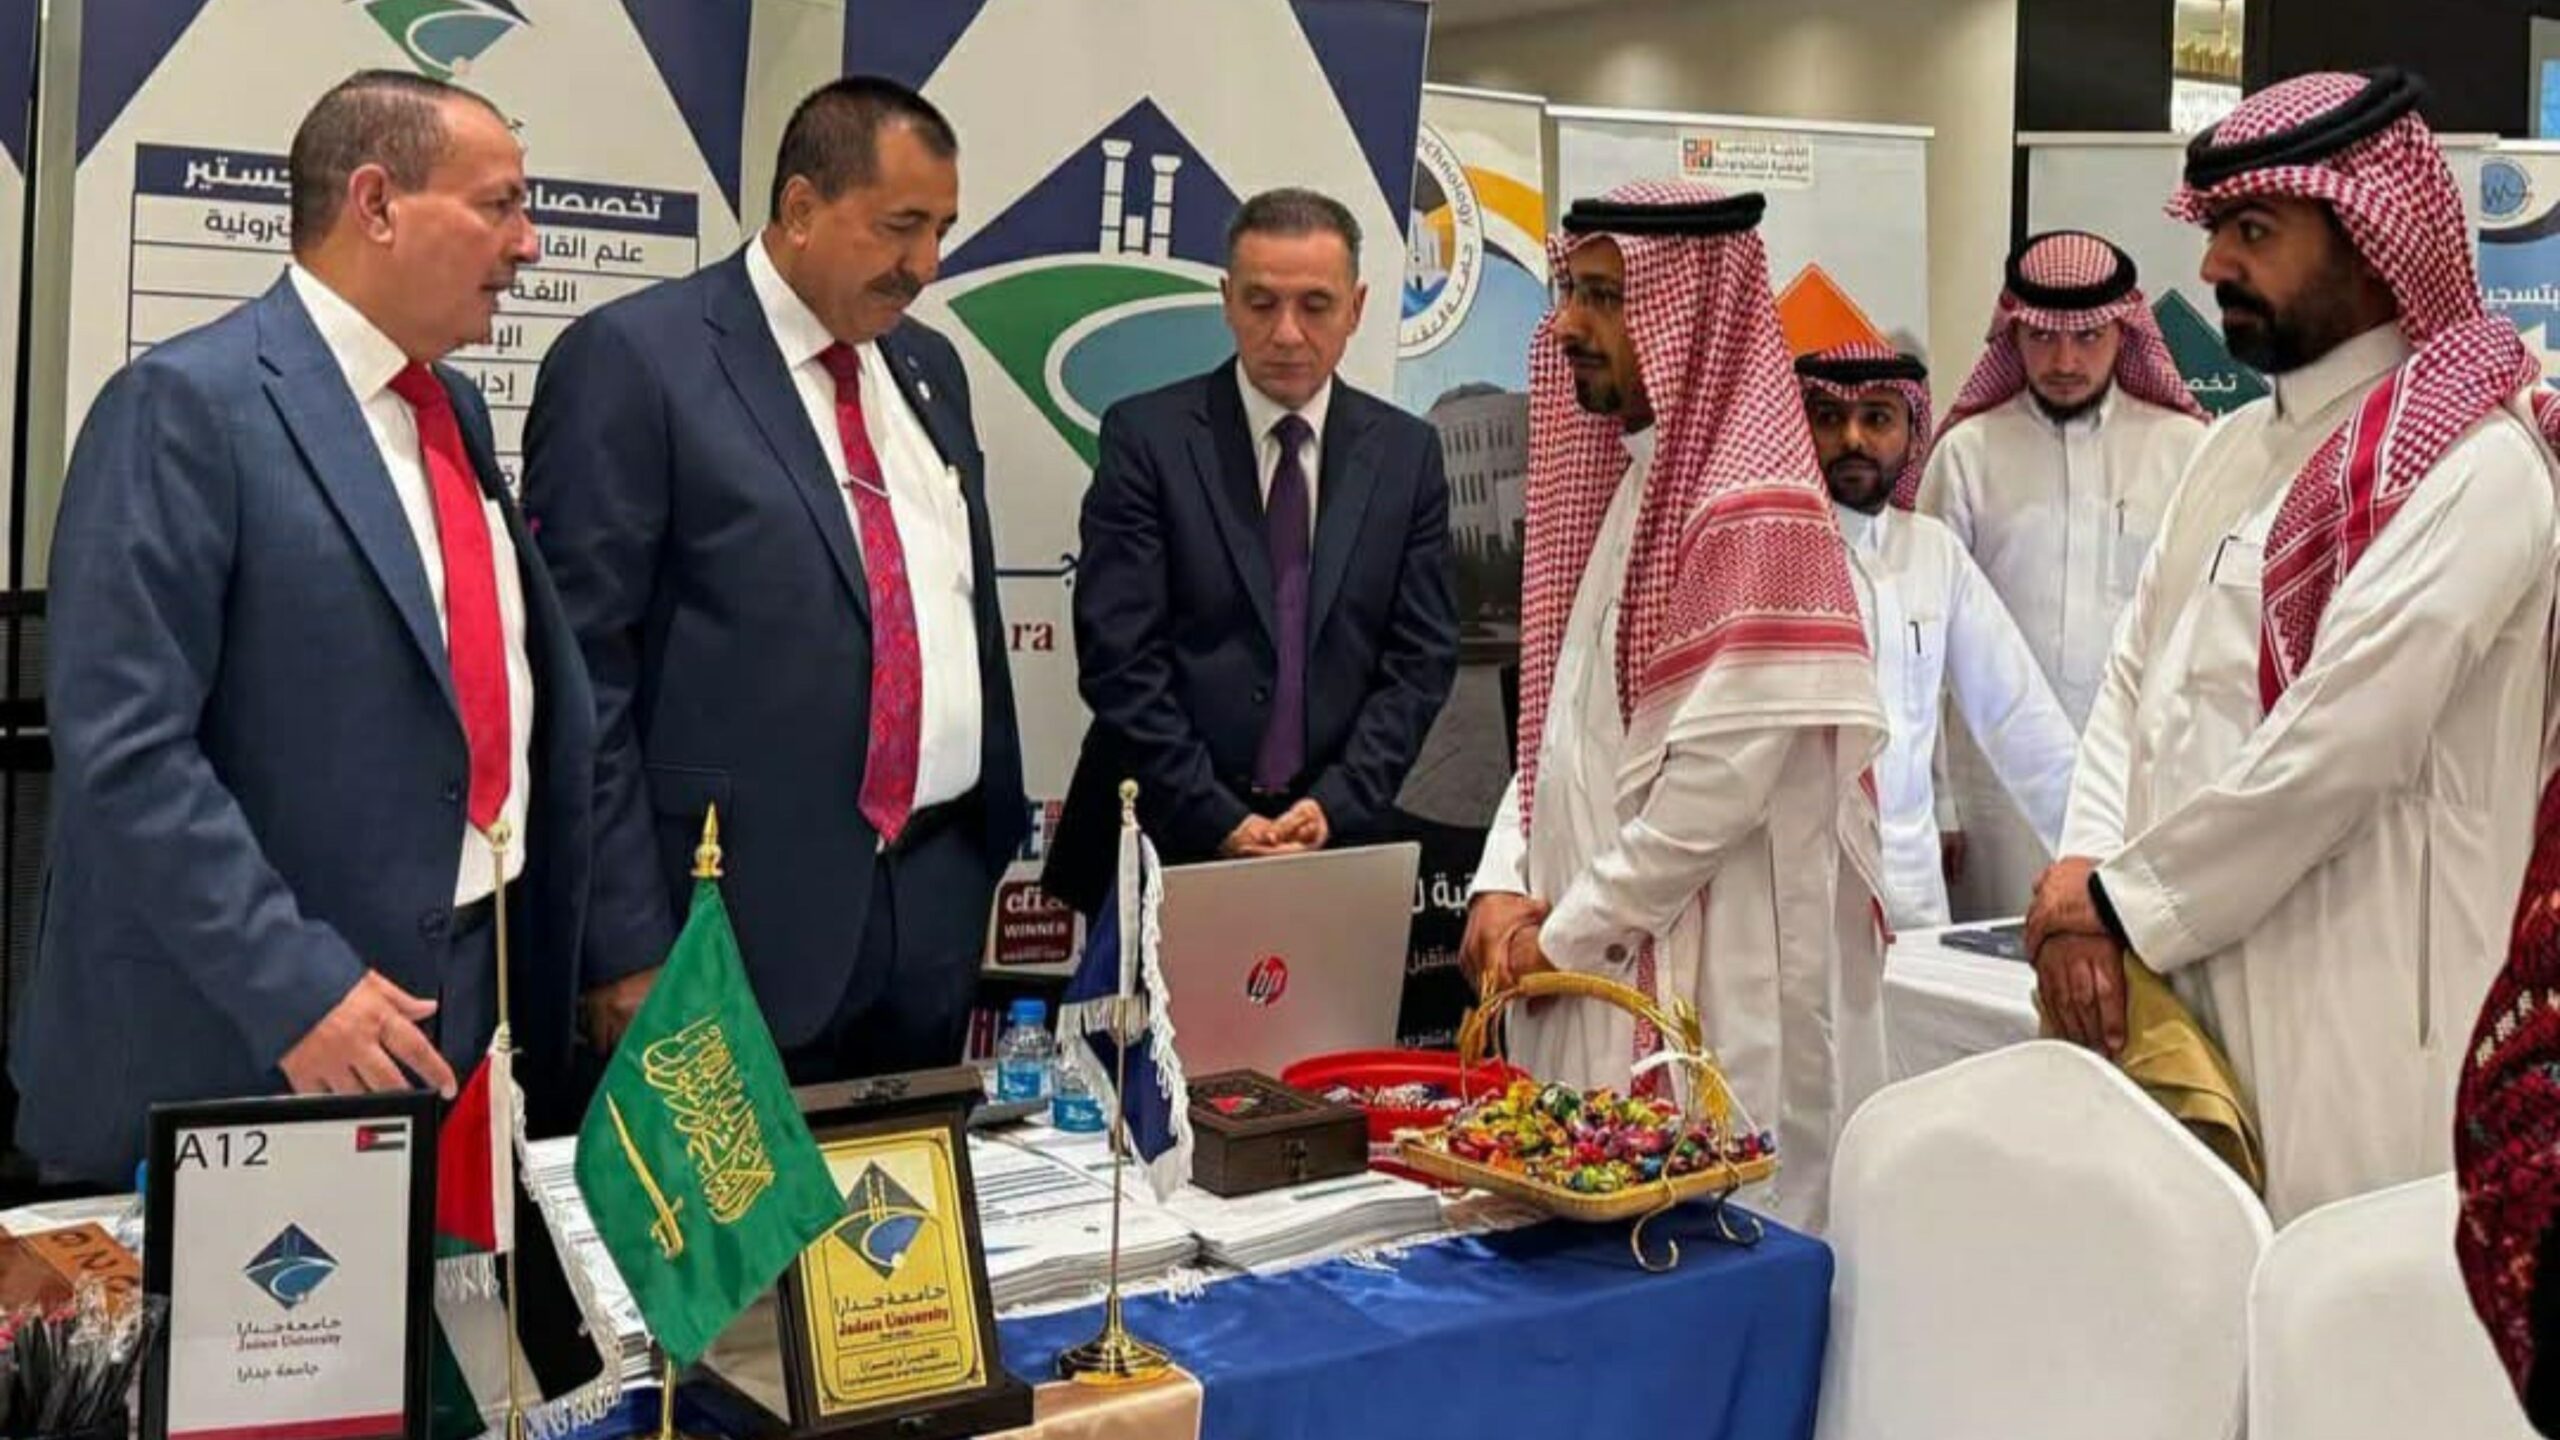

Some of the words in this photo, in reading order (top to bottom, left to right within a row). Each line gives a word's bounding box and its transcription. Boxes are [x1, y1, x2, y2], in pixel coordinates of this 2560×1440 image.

[594, 239, 645, 269] علم
[1004, 921, 1068, 938] WINNER
[1249, 955, 1288, 1006] hp
[175, 1130, 269, 1171] A12
[884, 1305, 949, 1328] University
[281, 1333, 341, 1348] University
